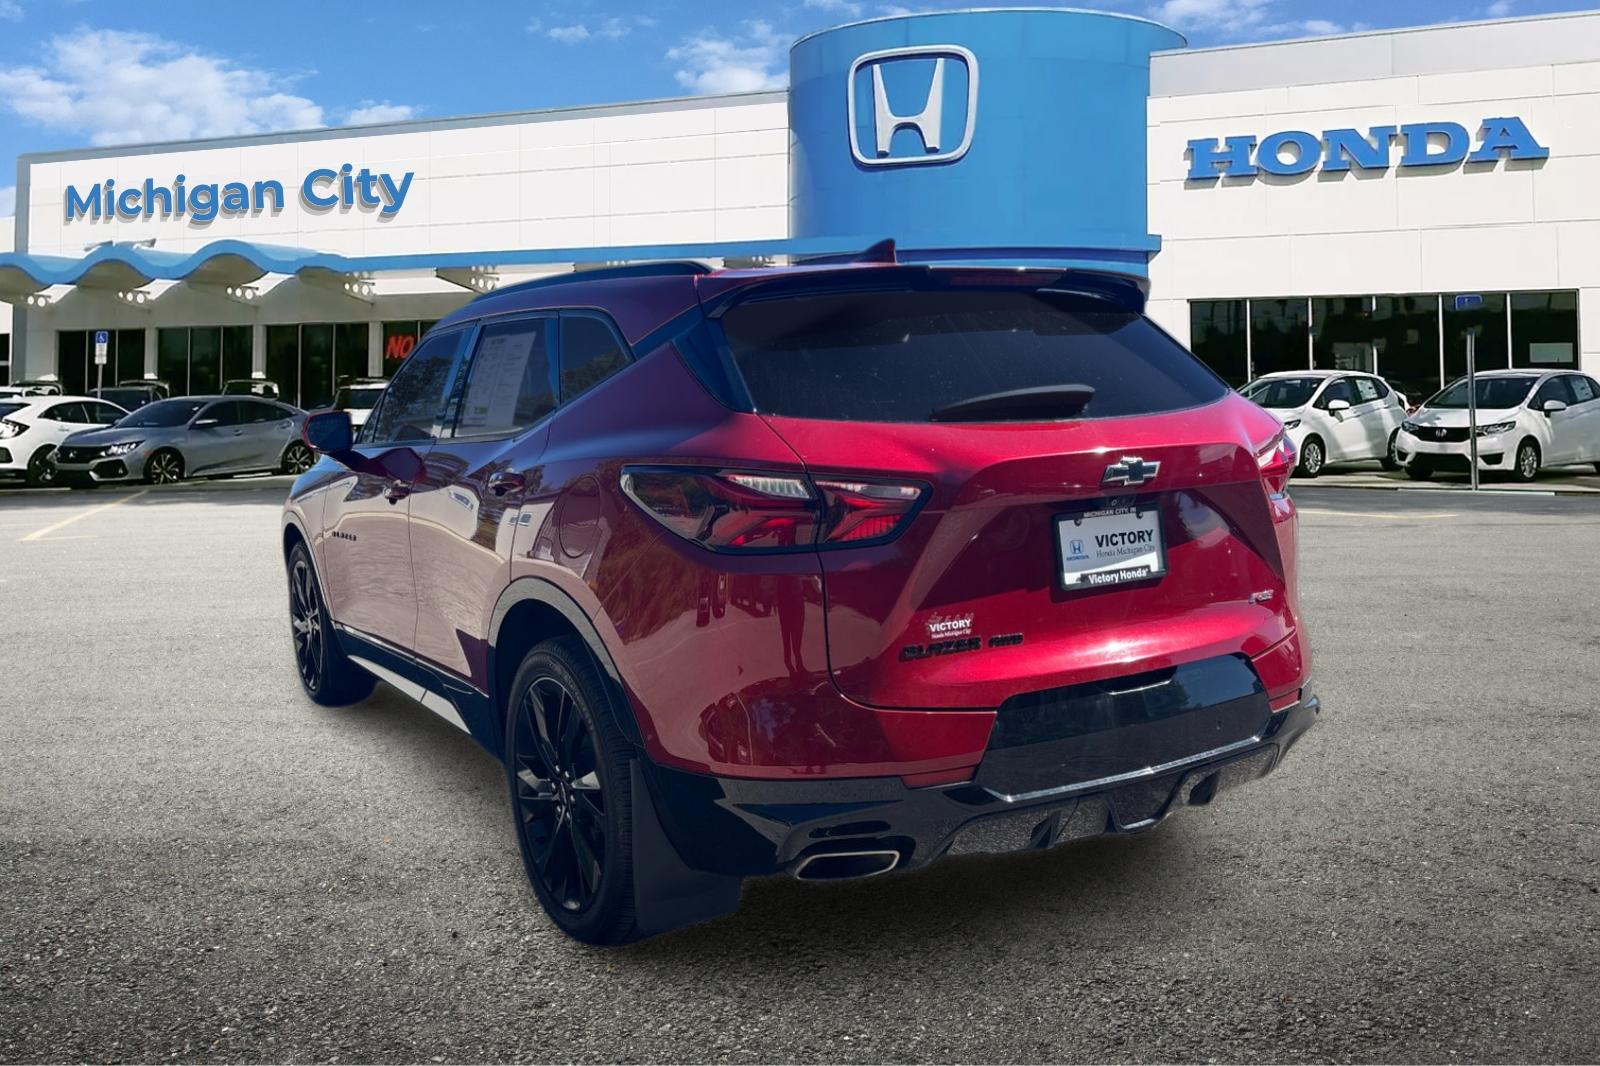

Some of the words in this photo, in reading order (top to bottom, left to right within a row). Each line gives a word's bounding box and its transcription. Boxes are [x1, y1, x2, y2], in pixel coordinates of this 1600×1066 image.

[1185, 116, 1550, 183] HONDA
[65, 173, 285, 224] Michigan
[301, 162, 415, 218] City
[1094, 529, 1154, 548] VICTORY
[1088, 572, 1119, 584] Victory
[1120, 568, 1148, 580] Honda
[929, 618, 972, 633] VICTORY
